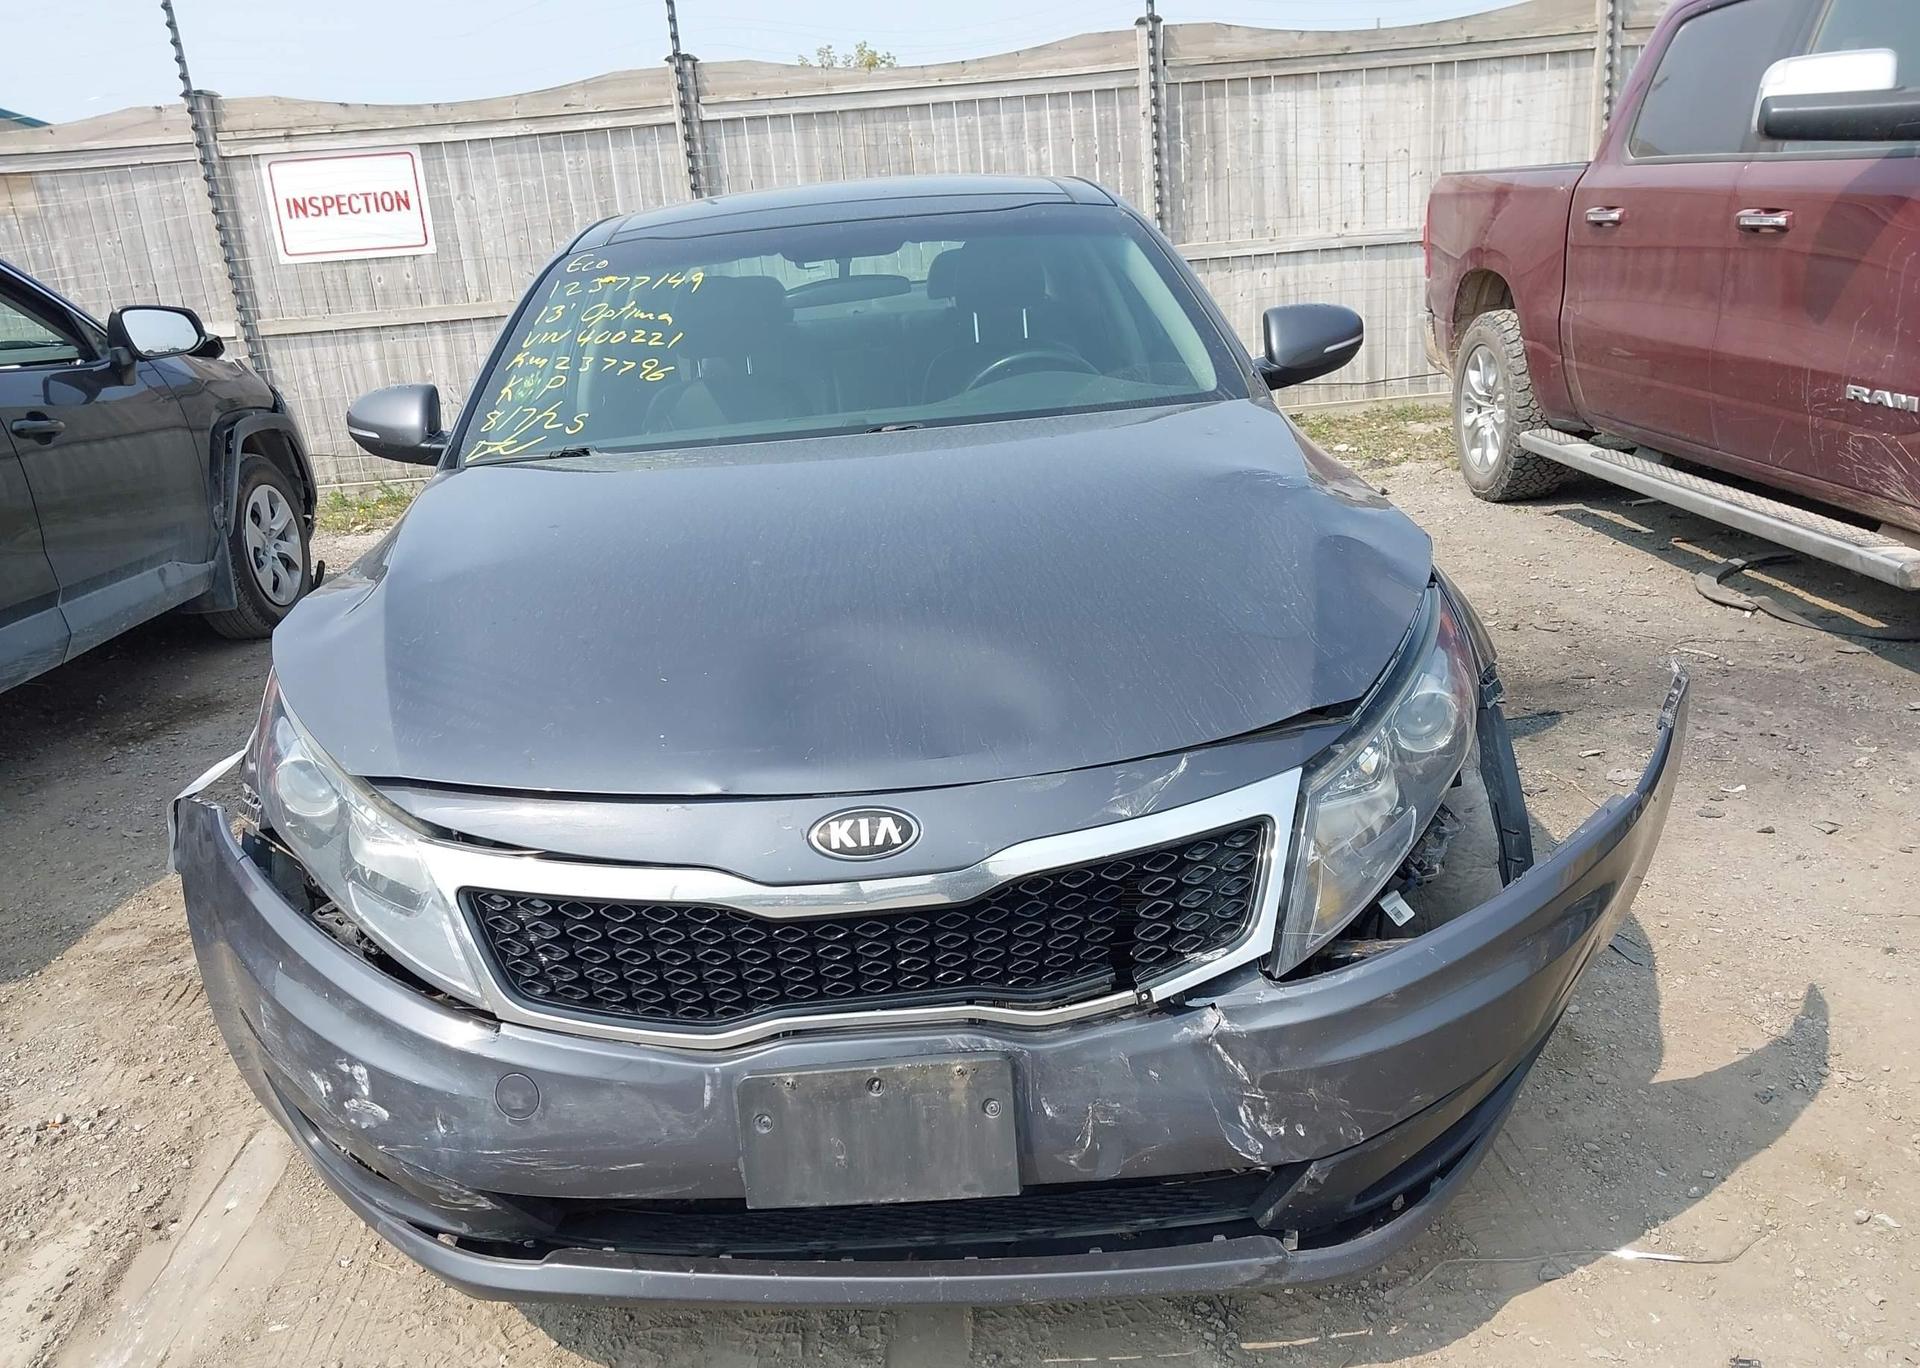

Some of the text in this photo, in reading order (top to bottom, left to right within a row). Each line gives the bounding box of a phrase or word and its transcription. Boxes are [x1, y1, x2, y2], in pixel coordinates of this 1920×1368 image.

[285, 190, 411, 219] INSPECTION
[580, 301, 673, 328] Optima
[576, 326, 684, 349] 400221
[554, 356, 675, 381] 237796
[1845, 384, 1919, 413] RAM
[828, 816, 902, 850] KIA
